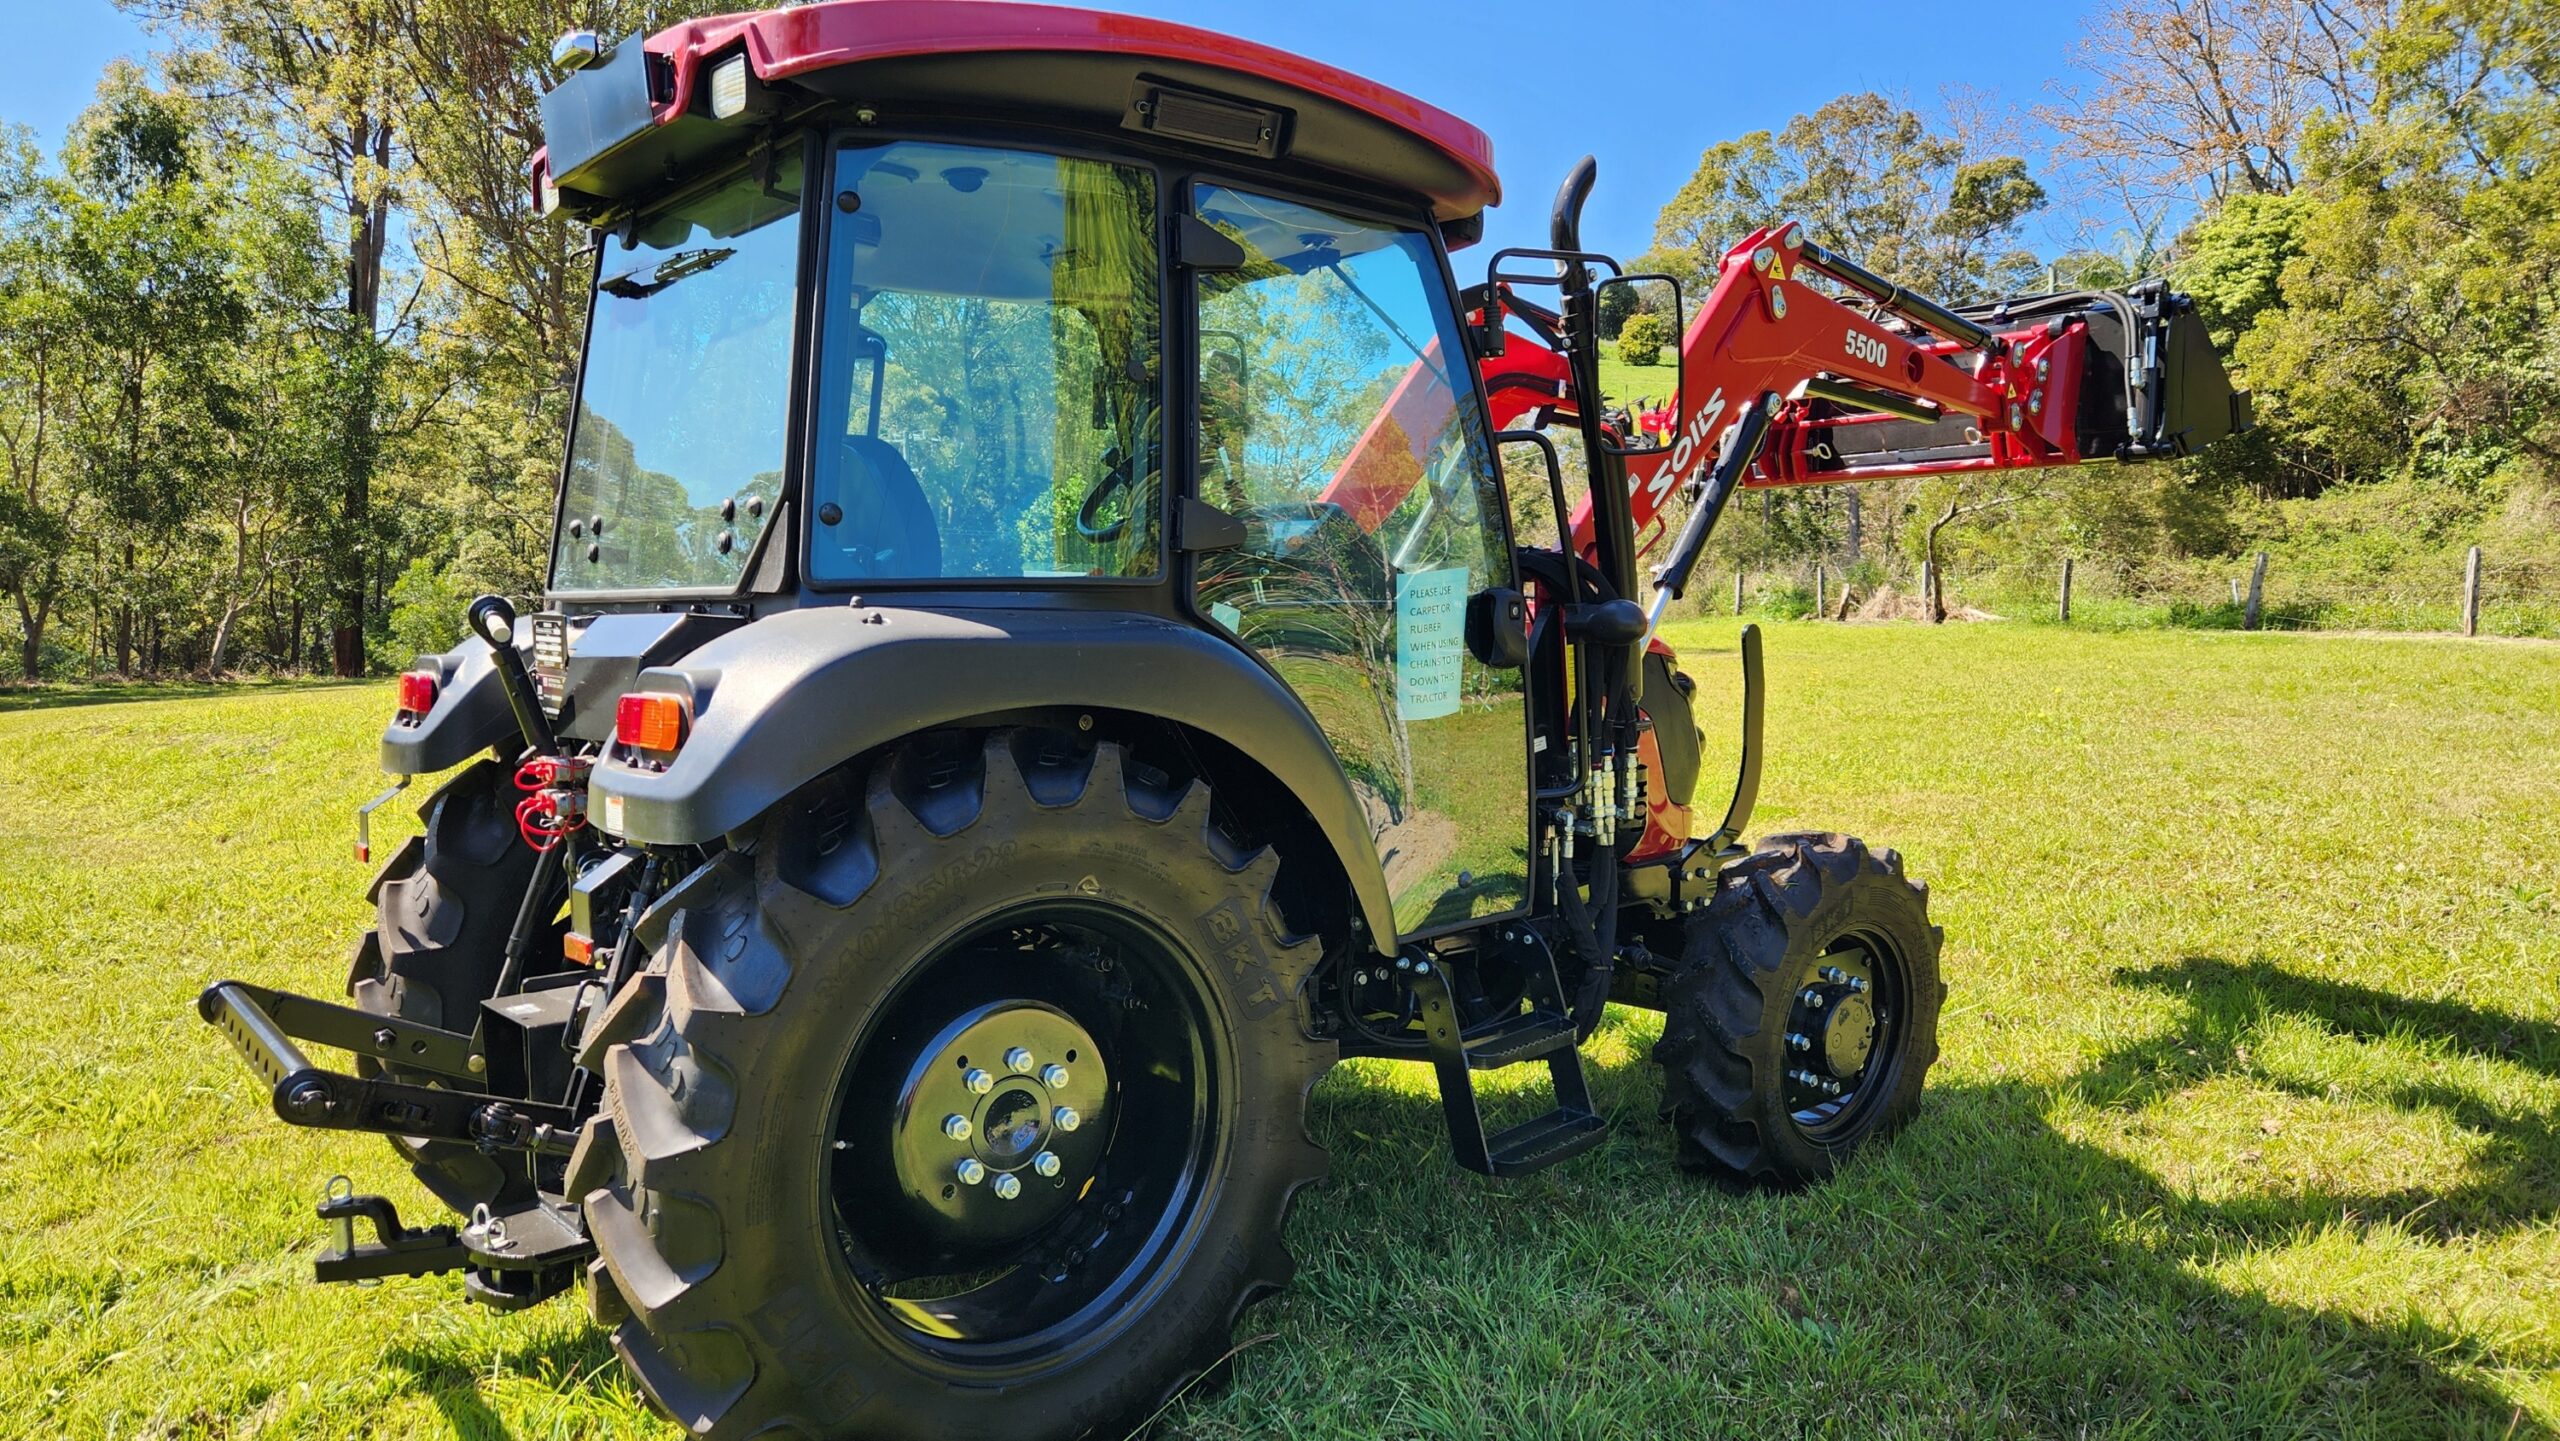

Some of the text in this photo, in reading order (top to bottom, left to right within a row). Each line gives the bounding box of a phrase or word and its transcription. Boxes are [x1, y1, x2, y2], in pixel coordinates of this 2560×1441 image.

[1845, 328, 1888, 368] 5500
[1410, 585, 1452, 598] PLEASE USE
[1410, 603, 1451, 616] CARPET OR
[1410, 622, 1441, 634] RUBBER
[1410, 637, 1459, 651] WHEN USING
[1410, 656, 1440, 669] CHAINS
[1442, 655, 1451, 665] TO
[1410, 671, 1455, 686] DOWN THIS
[1409, 691, 1448, 704] TRACTOR
[1205, 904, 1282, 1008] BKT
